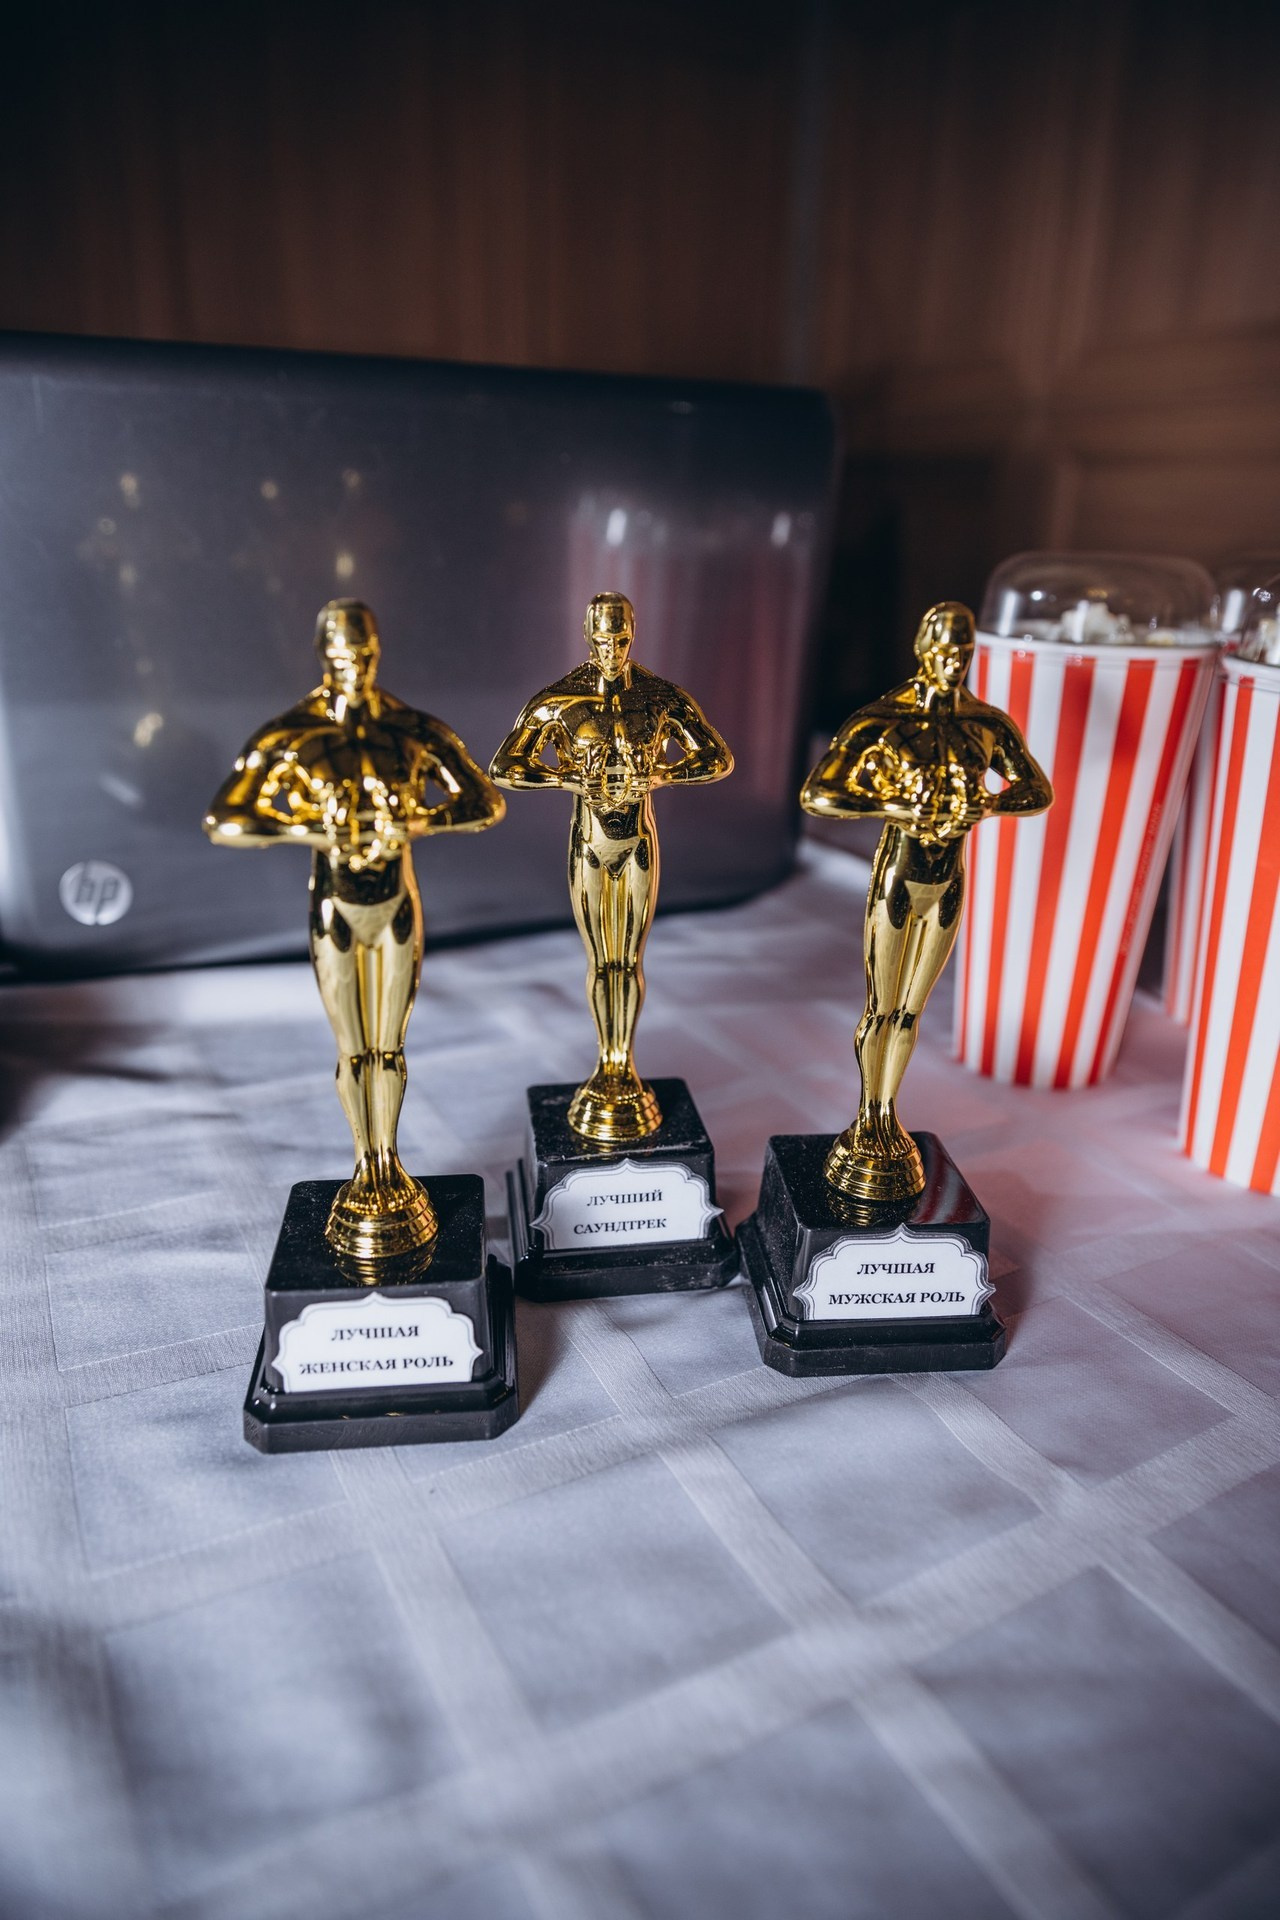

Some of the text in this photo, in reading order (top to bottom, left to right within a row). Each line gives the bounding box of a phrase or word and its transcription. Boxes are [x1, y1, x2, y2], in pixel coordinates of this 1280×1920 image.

[72, 861, 122, 924] hp
[586, 1189, 663, 1207] ЛУЧШИЙ
[573, 1218, 667, 1235] САУНДТРЕК
[856, 1262, 936, 1275] ЛУЧШАЯ
[828, 1291, 966, 1305] МУЖСКАЯ РОЛЬ
[330, 1325, 420, 1342] ЛУЧШАЯ
[299, 1356, 454, 1375] ЖЕНСКАЯ РОЛЬ
